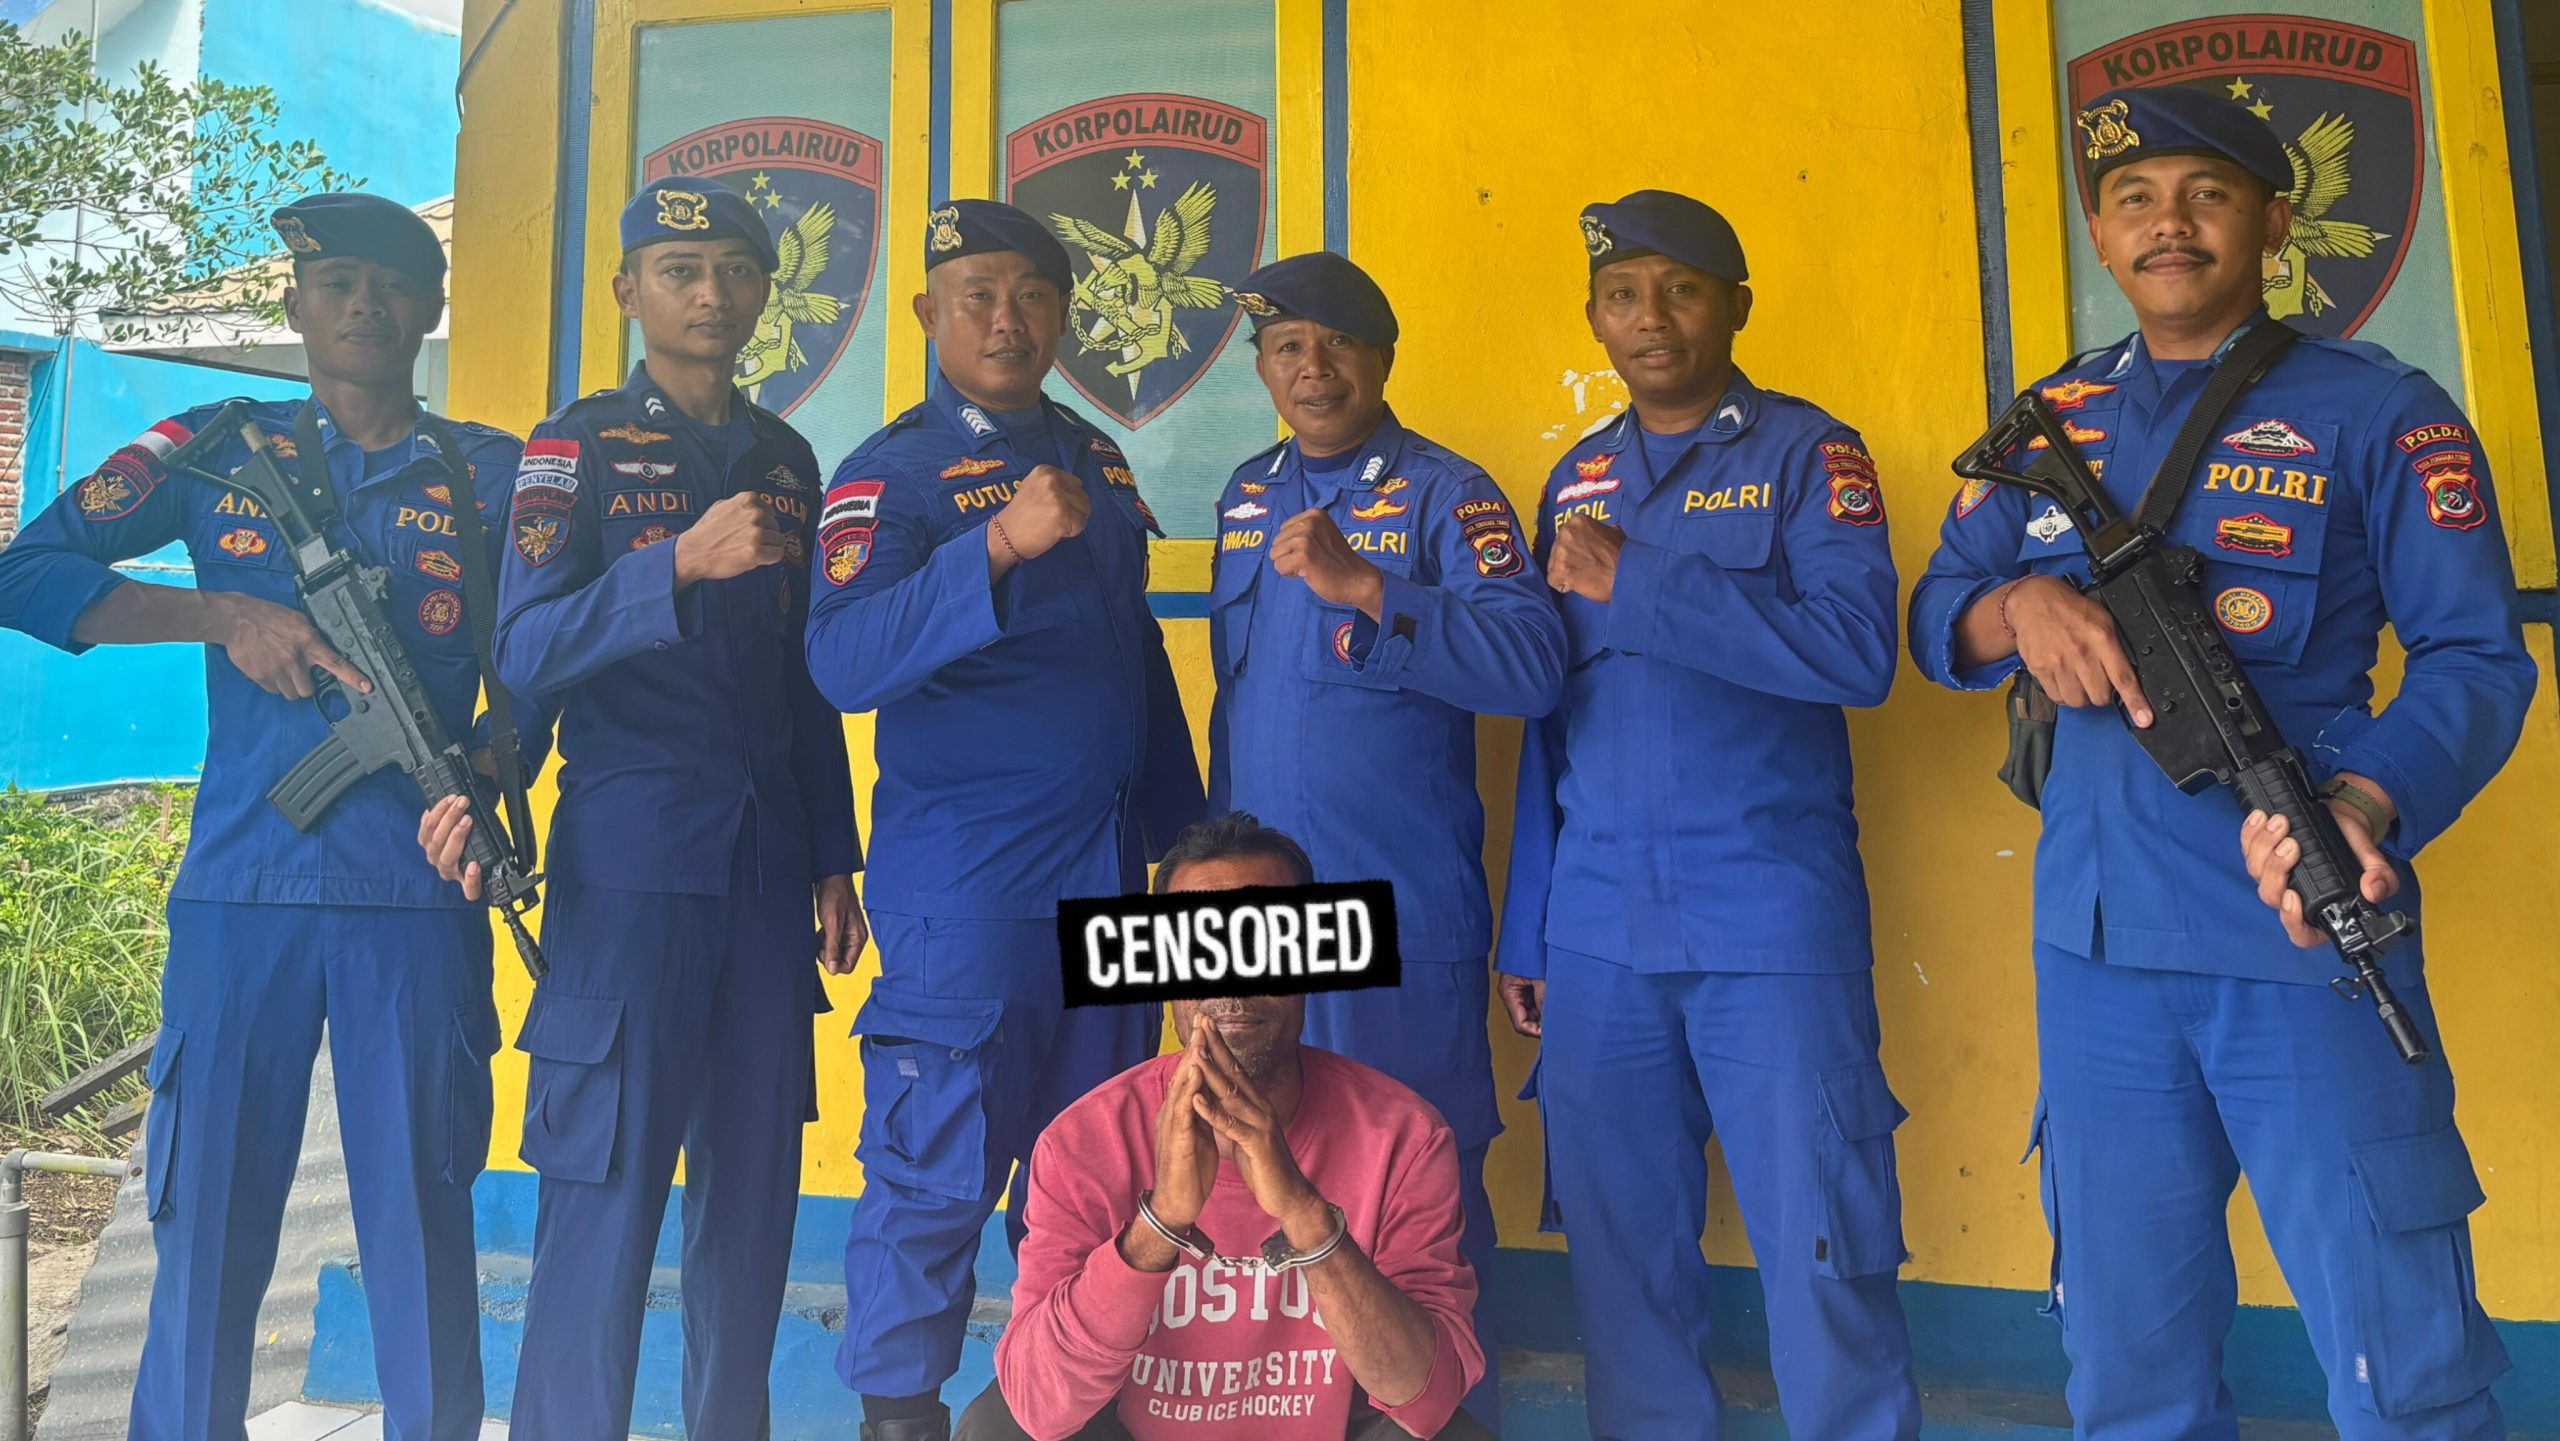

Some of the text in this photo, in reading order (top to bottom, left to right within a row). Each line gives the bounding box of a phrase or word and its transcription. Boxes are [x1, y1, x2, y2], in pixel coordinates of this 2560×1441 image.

[2102, 30, 2383, 87] KORPOLAIRUD
[1033, 107, 1243, 157] KORPOLAIRUD
[667, 130, 861, 175] KORPOLAIRUD
[2404, 426, 2463, 448] POLDA
[524, 457, 573, 469] INDONESIA
[518, 474, 576, 491] PENYELAM
[2203, 463, 2328, 505] POLRI
[213, 491, 268, 520] AN
[609, 491, 689, 516] ANDI
[1456, 502, 1501, 519] POLDA
[1683, 482, 1771, 514] POLRI
[1343, 530, 1407, 555] OLRI
[1150, 1258, 1327, 1336] OSTO
[1131, 1348, 1337, 1397] UNIVERSITY
[1148, 1394, 1316, 1422] CLUB ICE HOCKEY
